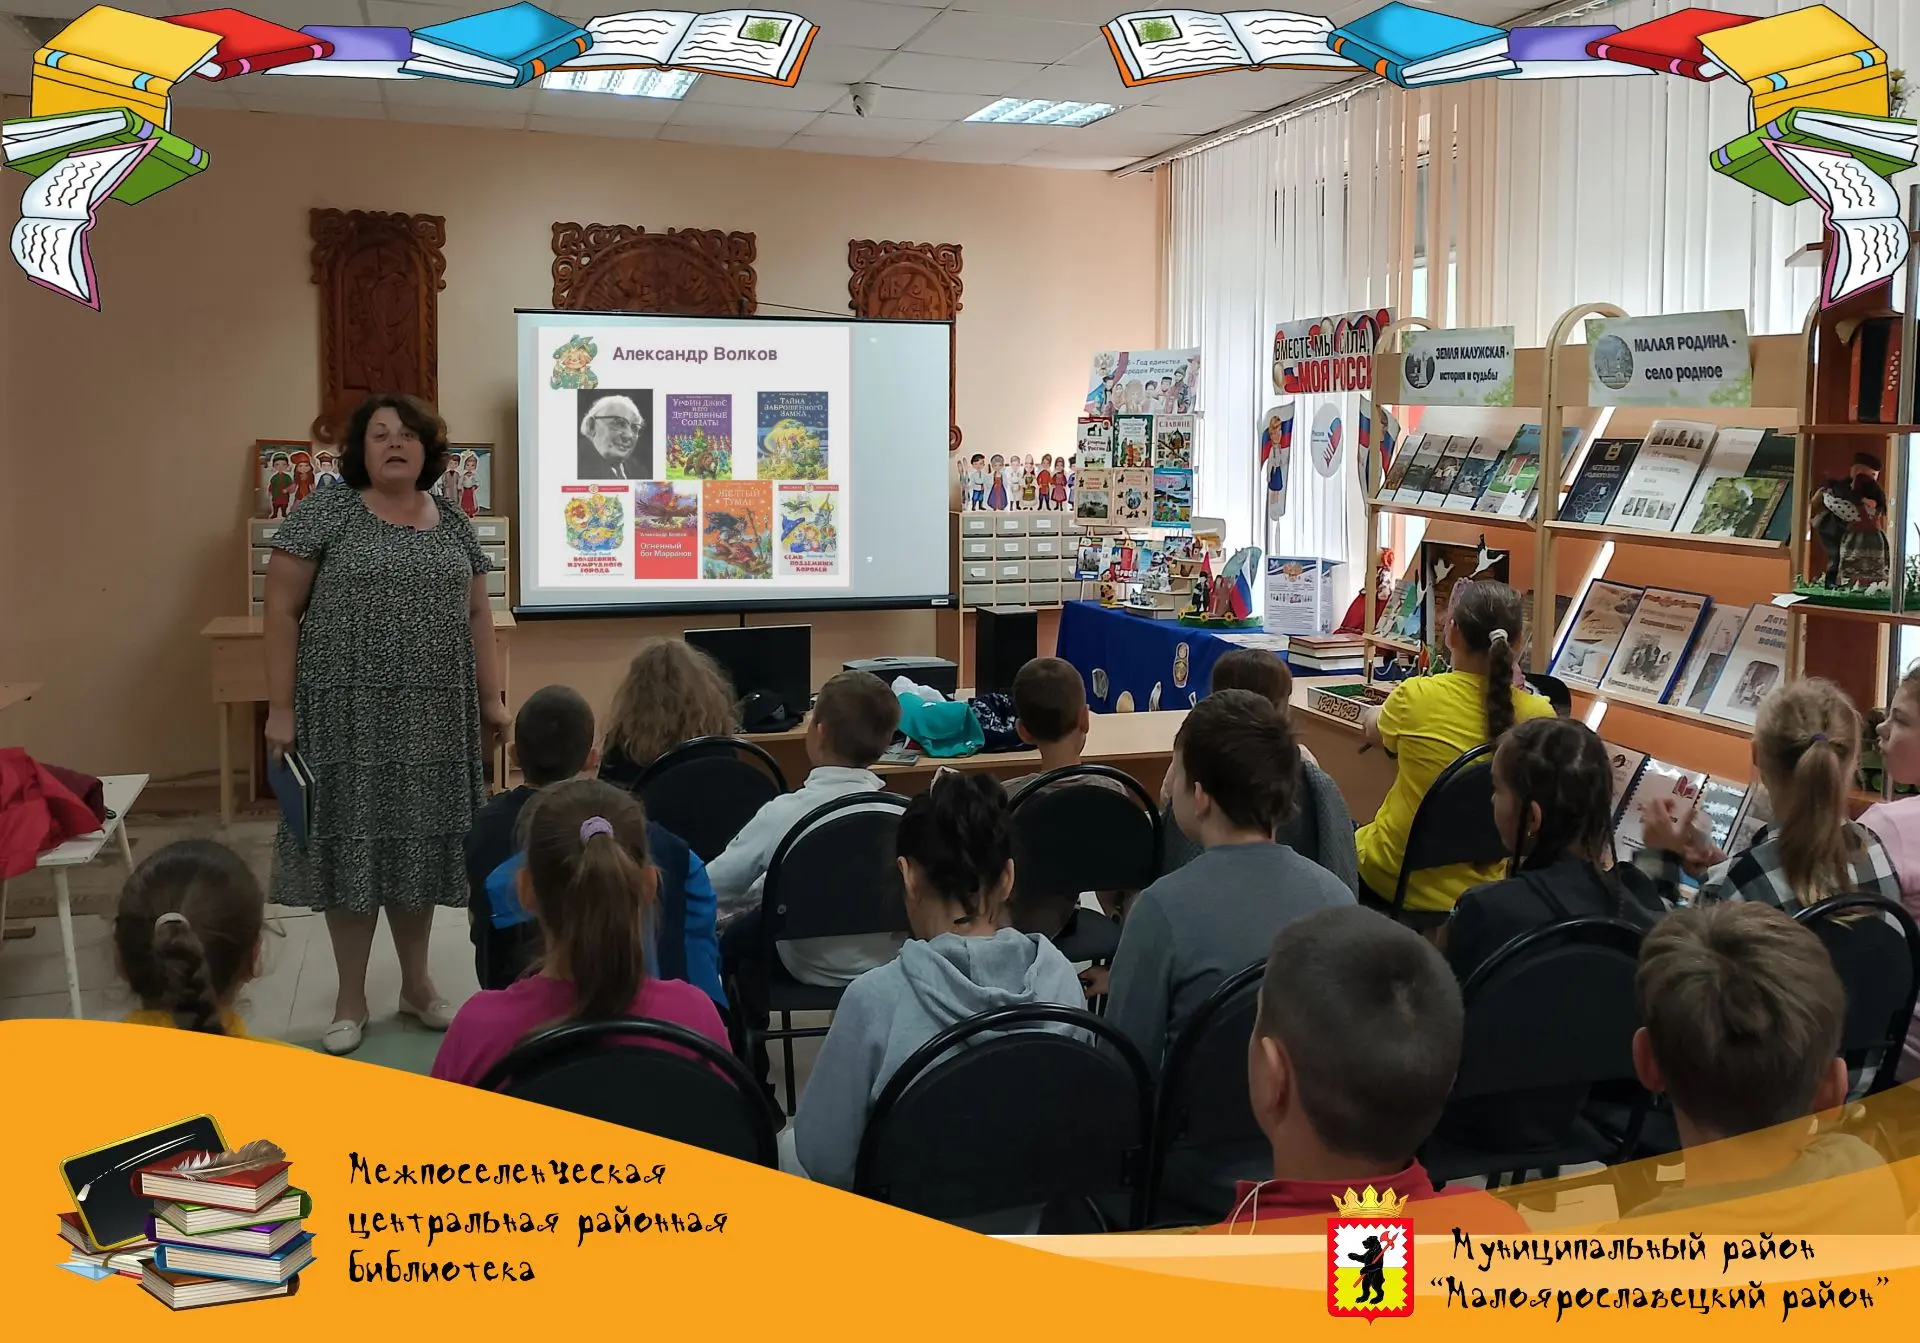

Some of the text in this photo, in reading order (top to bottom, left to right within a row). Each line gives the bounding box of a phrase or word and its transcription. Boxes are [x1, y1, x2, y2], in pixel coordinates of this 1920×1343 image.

[1275, 336, 1312, 361] ВМЕСТЕ
[1315, 334, 1334, 353] МЫ
[1634, 336, 1675, 352] МАЛАЯ
[1677, 333, 1730, 352] РОДИНА
[612, 346, 778, 364] Александр Волков
[1435, 346, 1459, 361] ЗЕМЛЯ
[1459, 344, 1505, 360] КАЛУЖСКАЯ
[1297, 356, 1330, 393] МОЯ
[1439, 368, 1498, 384] история и судьбы
[1645, 364, 1723, 383] село родное
[779, 397, 806, 405] ТАЙНА
[654, 551, 692, 559] Марранов
[1317, 694, 1361, 721] 1941-1945
